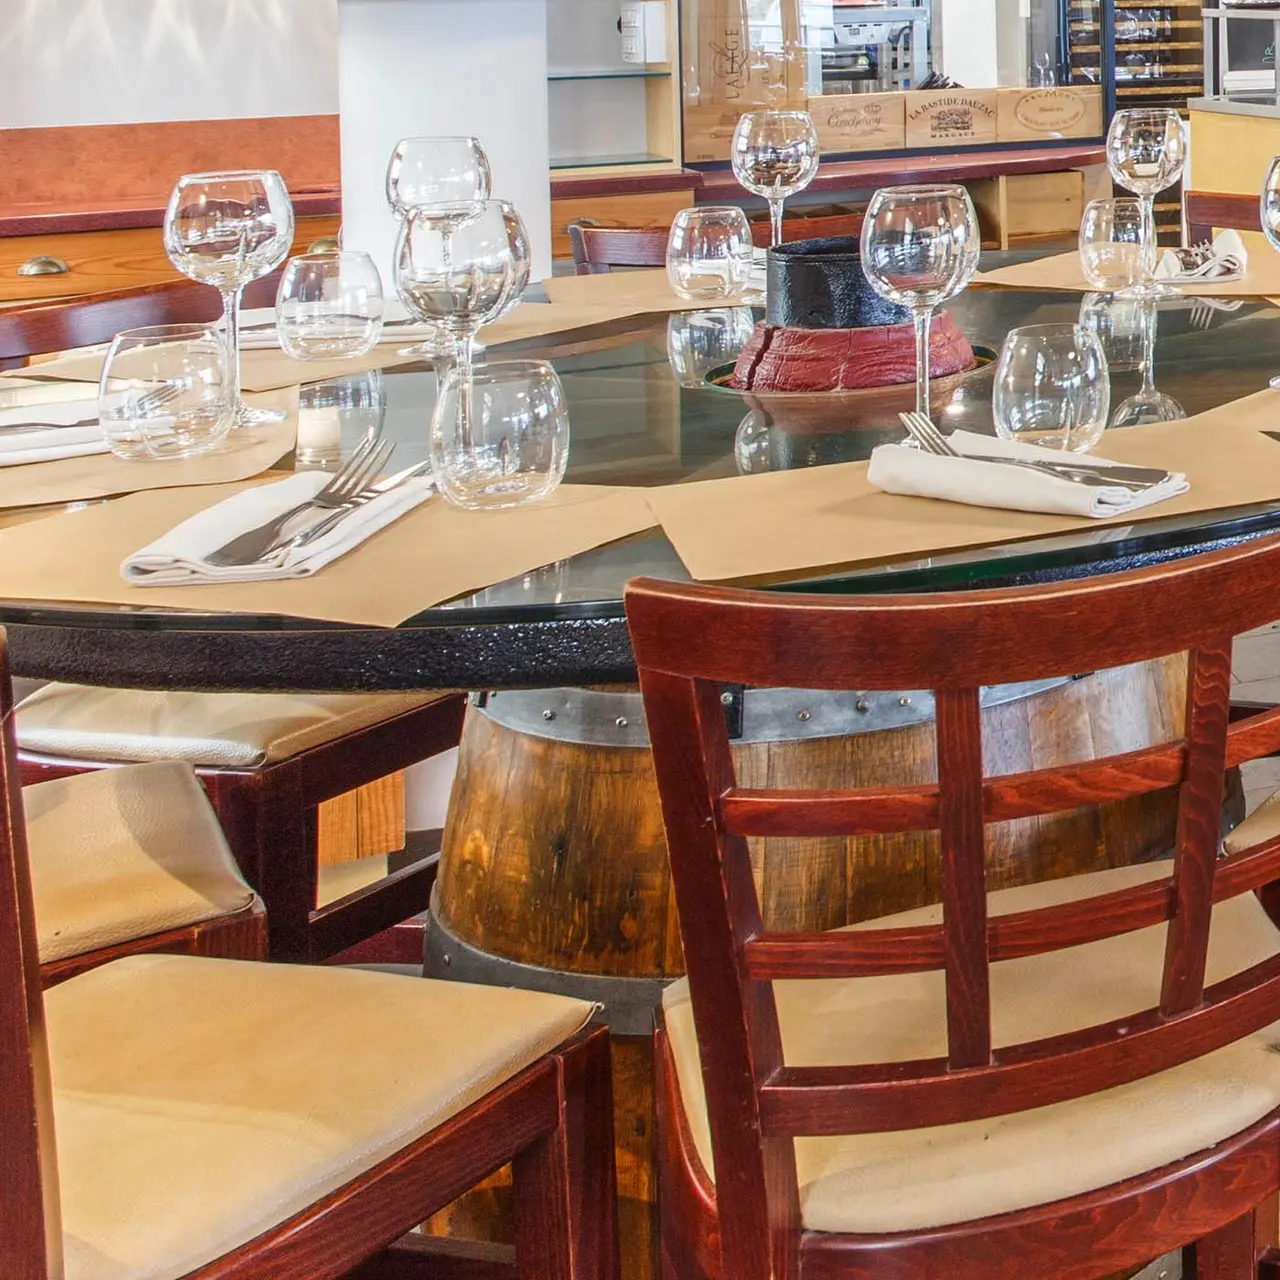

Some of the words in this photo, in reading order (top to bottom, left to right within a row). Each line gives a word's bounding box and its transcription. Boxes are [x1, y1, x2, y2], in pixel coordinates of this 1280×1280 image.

[908, 110, 921, 121] LA
[921, 97, 958, 114] BASTIDE
[931, 131, 975, 139] MARGAUX
